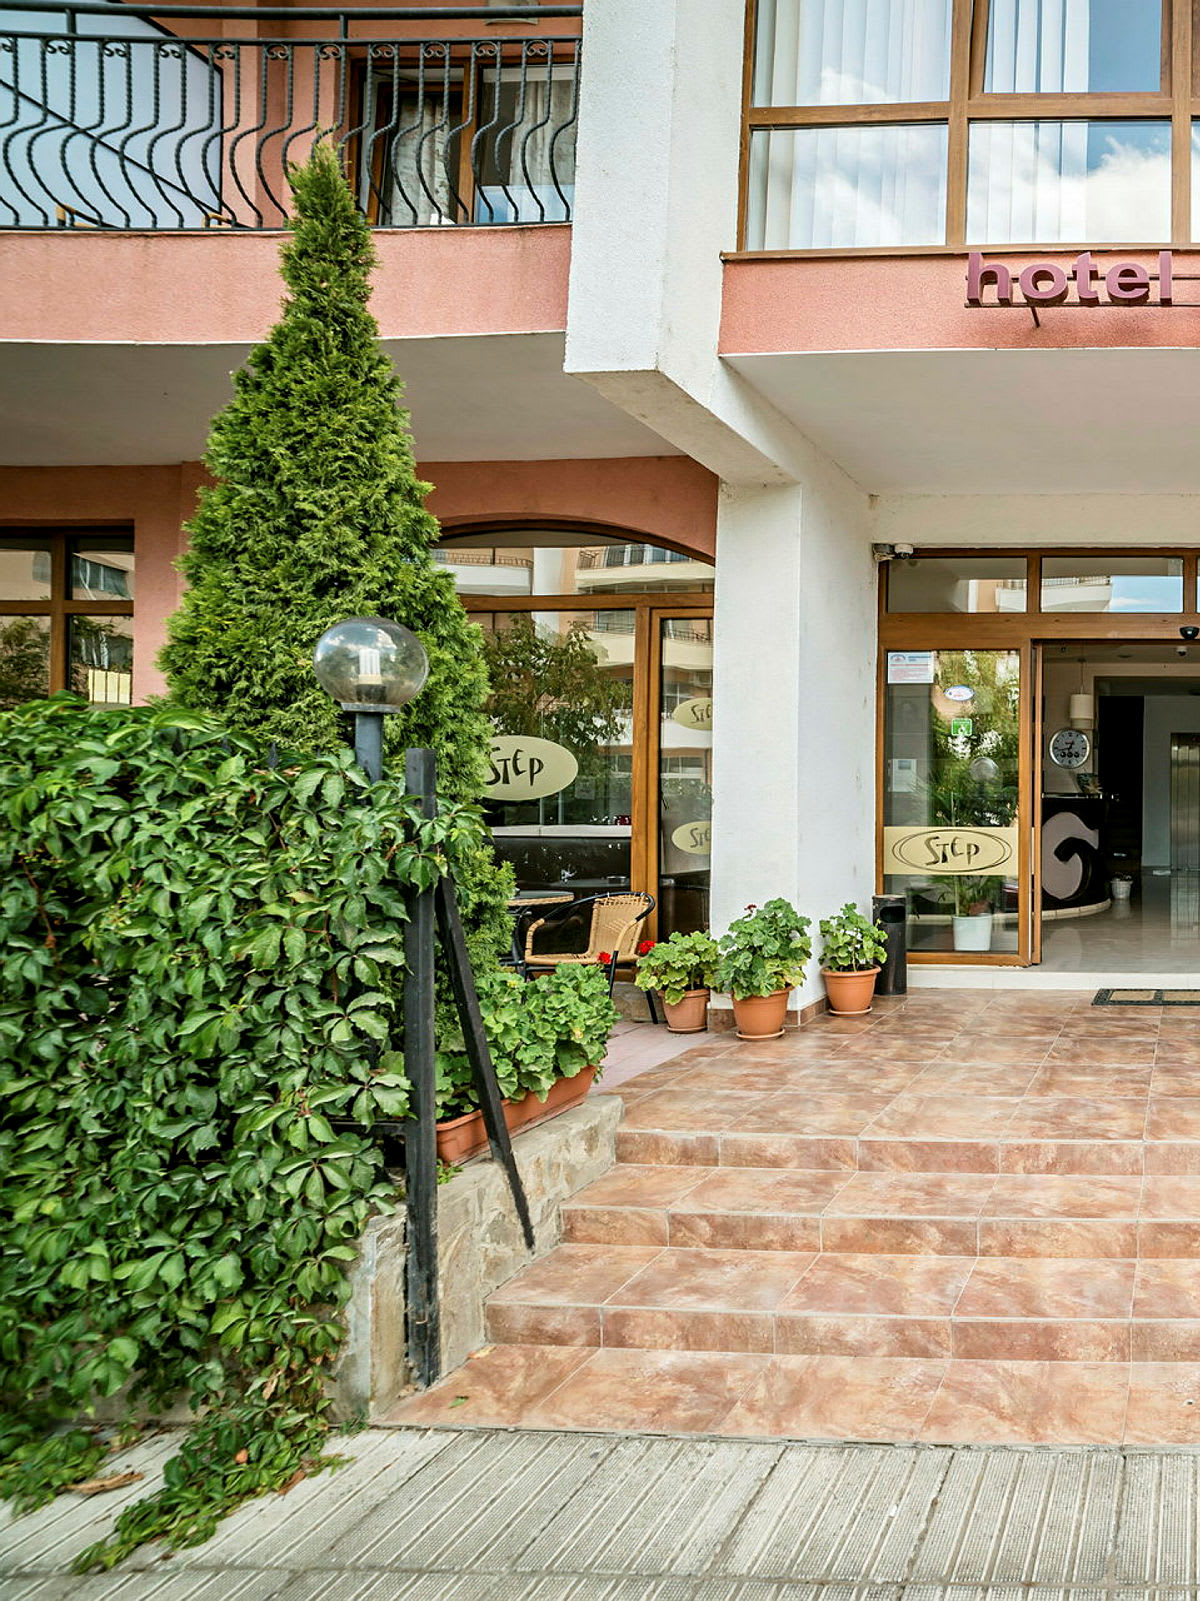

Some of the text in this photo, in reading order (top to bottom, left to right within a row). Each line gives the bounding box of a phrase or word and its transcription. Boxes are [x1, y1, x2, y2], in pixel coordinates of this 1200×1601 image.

[968, 252, 1172, 306] hotel
[691, 704, 711, 723] STE
[924, 836, 980, 865] STEP
